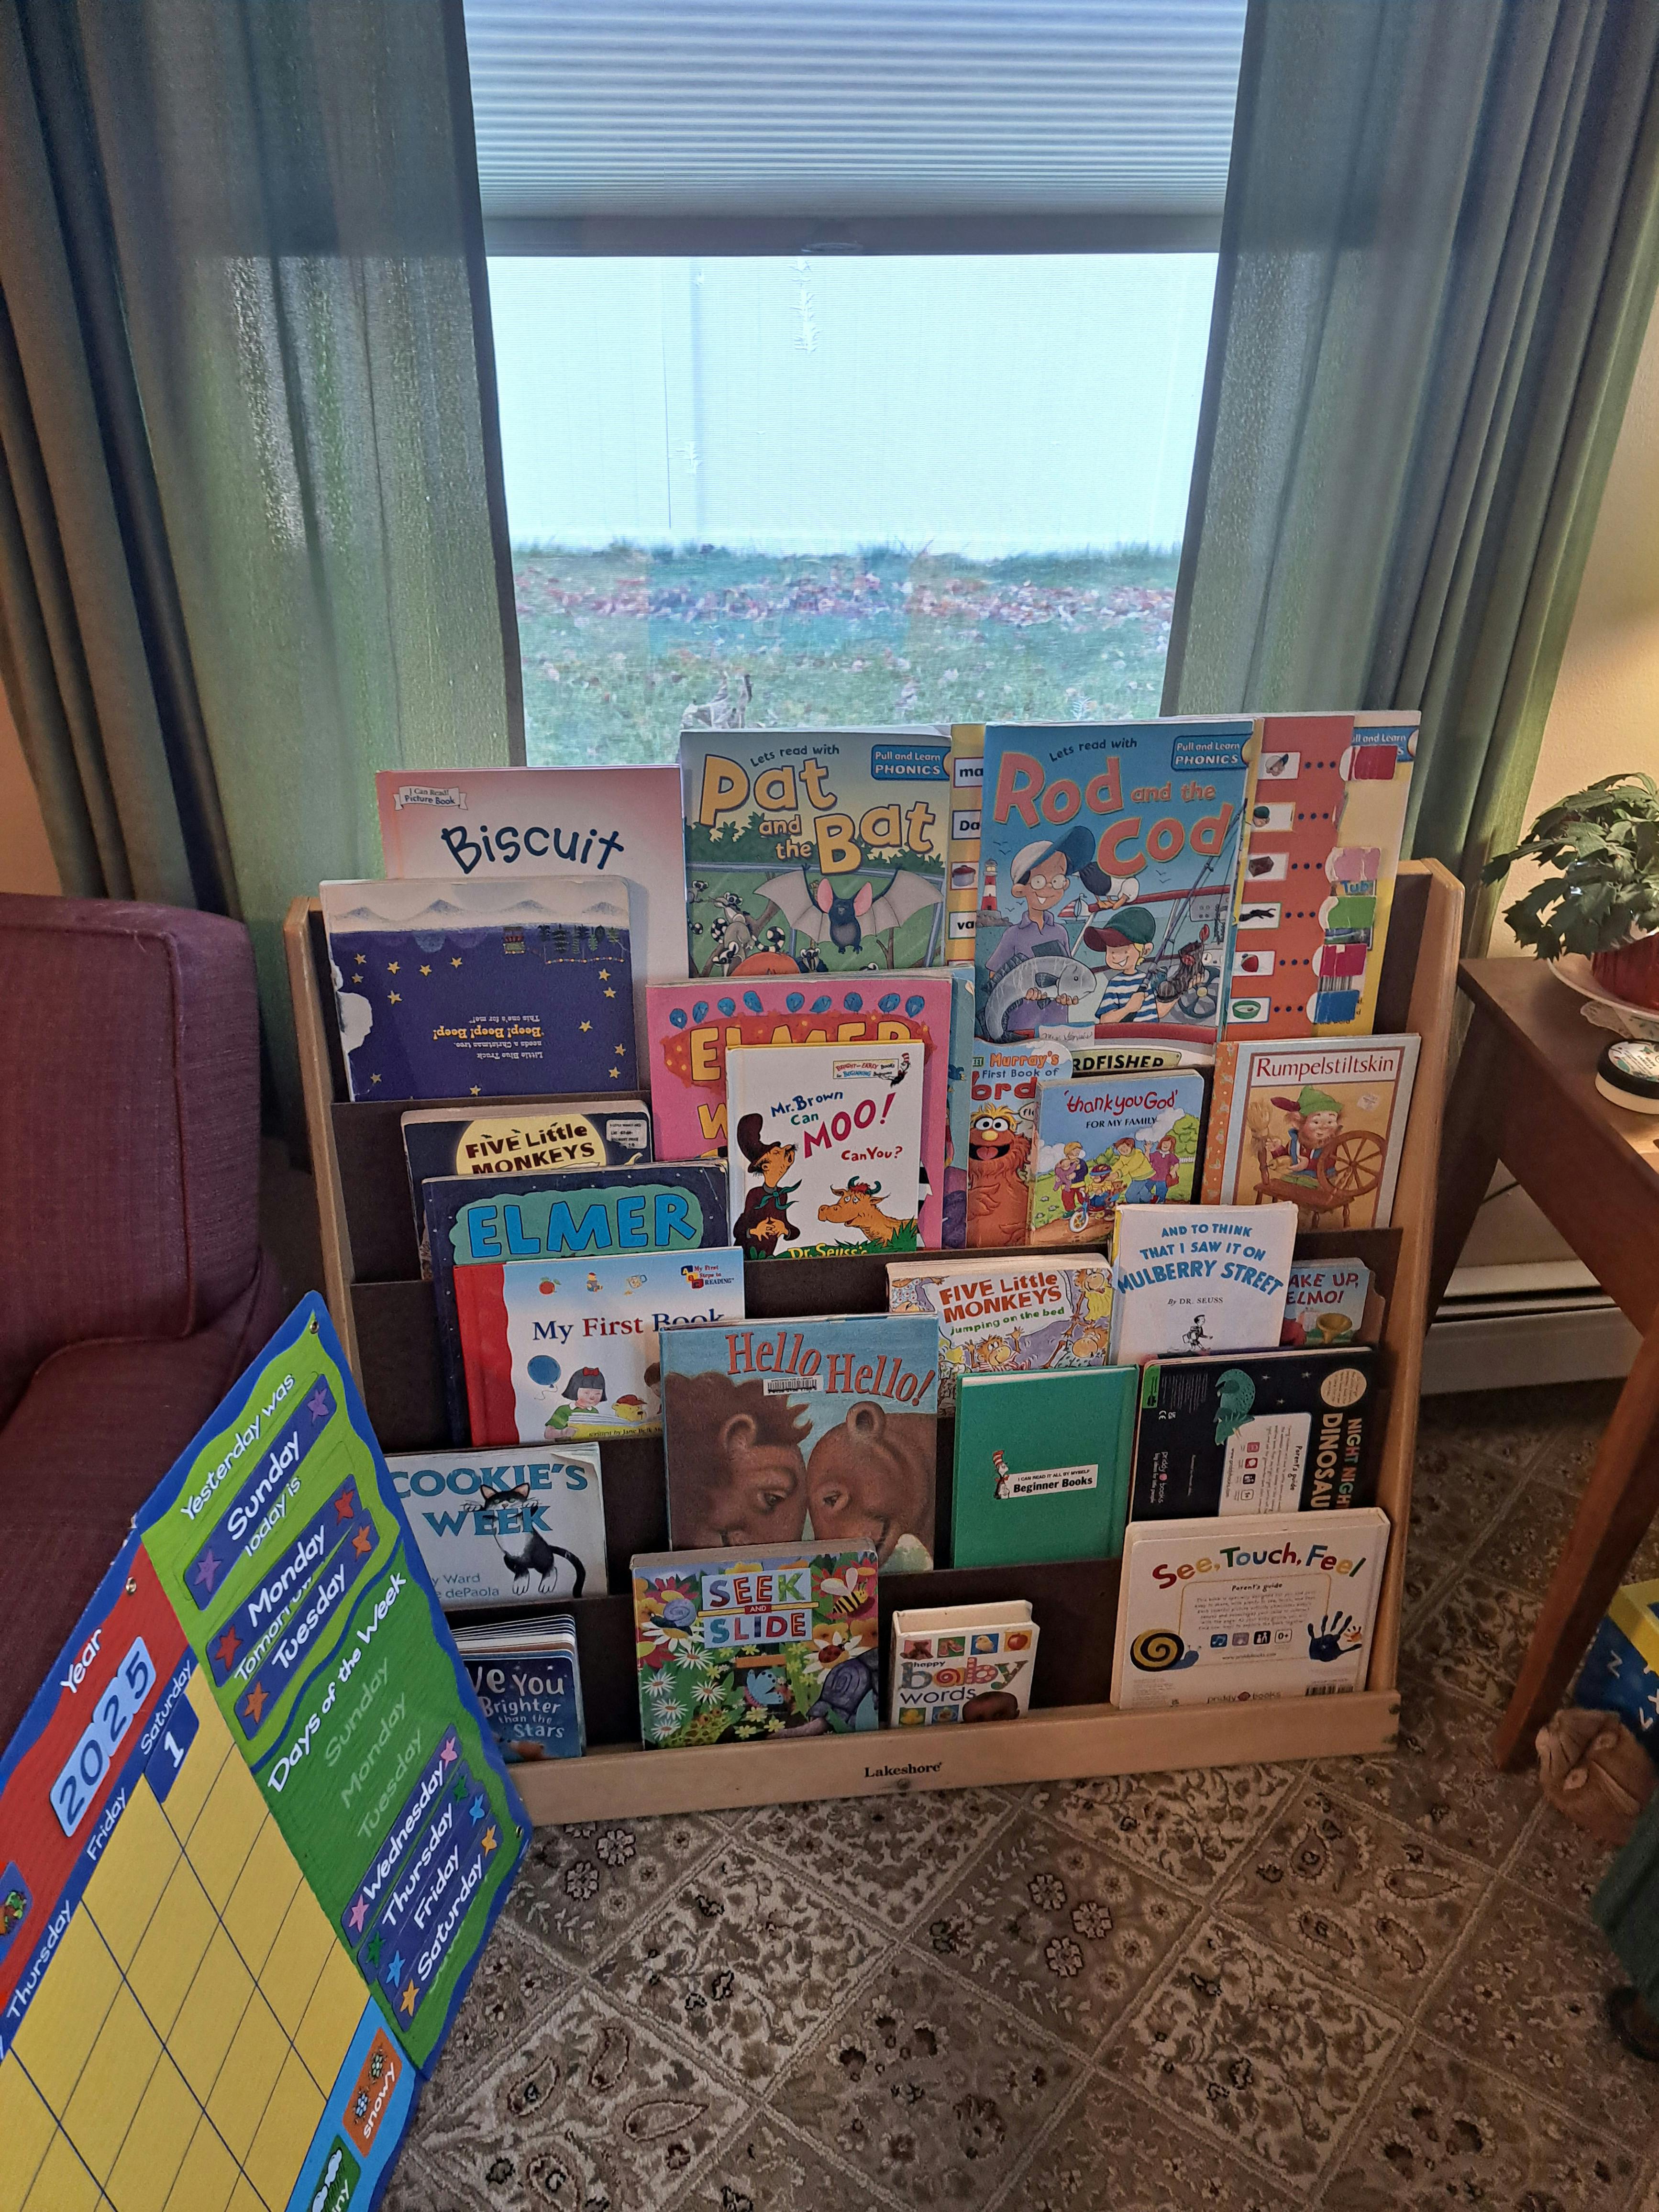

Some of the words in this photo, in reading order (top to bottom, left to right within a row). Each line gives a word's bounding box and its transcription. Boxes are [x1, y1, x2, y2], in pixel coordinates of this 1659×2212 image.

[1049, 747, 1074, 762] Lets
[1079, 740, 1106, 751] read
[1111, 738, 1137, 748] with
[1176, 742, 1194, 751] Pull
[1196, 742, 1213, 751] and
[1215, 741, 1240, 751] Learn
[1352, 734, 1360, 742] ull
[1363, 733, 1380, 742] and
[750, 751, 775, 767] Lets
[780, 746, 807, 757] read
[812, 744, 840, 755] with
[874, 764, 940, 775] PHONICS
[875, 751, 893, 760] Pull
[895, 752, 912, 761] and
[914, 752, 940, 762] Learn
[1175, 754, 1239, 765] PHONICS
[405, 795, 433, 803] Picture
[435, 796, 455, 805] Book
[699, 754, 837, 828] Pat
[993, 751, 1124, 828] Rod
[1131, 782, 1172, 803] and
[1181, 782, 1216, 803] the
[759, 815, 802, 837] and
[814, 801, 936, 875] Bat
[1097, 802, 1234, 878] Cod
[441, 825, 624, 874] Biscuit
[775, 842, 811, 860] the
[1339, 880, 1369, 894] Tub
[433, 1026, 467, 1040] Beep!
[470, 1025, 505, 1039] Beep!
[983, 1070, 1006, 1078] First
[1011, 1069, 1040, 1077] Book
[1045, 1068, 1060, 1076] of
[990, 1051, 1060, 1069] Murray's
[1256, 1055, 1394, 1081] Rumpelstiltskin
[771, 1101, 794, 1117] Mr.
[795, 1090, 843, 1111] Brown
[1113, 1095, 1143, 1116] you
[790, 1112, 818, 1126] Can
[804, 1092, 896, 1159] MOO!
[1086, 1120, 1105, 1128] FOR
[1125, 1117, 1156, 1126] FAMILY
[465, 1135, 522, 1159] FIVE
[526, 1122, 588, 1147] Little
[471, 1142, 596, 1174] MONKEYS
[467, 1194, 697, 1259] ELMER
[1161, 1227, 1187, 1238] AND
[1191, 1224, 1208, 1234] TO
[1212, 1223, 1253, 1238] THINK
[1139, 1244, 1175, 1260] THAT
[1180, 1243, 1184, 1254] I
[1191, 1241, 1221, 1253] SAW
[1226, 1242, 1242, 1254] IT
[1242, 1247, 1266, 1261] ON
[939, 1279, 993, 1306] FIVE
[999, 1272, 1058, 1294] Little
[1117, 1260, 1217, 1294] MULBERRY
[1220, 1262, 1284, 1295] STREET
[1290, 1273, 1325, 1287] AKE
[1332, 1273, 1359, 1288] UP,
[942, 1285, 1062, 1324] MONKEYS
[1286, 1291, 1345, 1305] ELMO!
[532, 1320, 574, 1344] My
[582, 1316, 643, 1337] First
[950, 1319, 1001, 1336] jumping
[1003, 1315, 1018, 1323] on
[1020, 1310, 1040, 1321] the
[1042, 1307, 1065, 1317] bed
[725, 1331, 821, 1376] Hello
[825, 1353, 936, 1406] Hello!
[180, 1416, 261, 1520] Yesterday
[261, 1372, 296, 1418] was
[1344, 1418, 1362, 1464] NIGHT
[1292, 1445, 1303, 1472] Parent's
[1311, 1413, 1343, 1509] DINOSAU
[227, 1432, 300, 1540] Sunday
[288, 1476, 302, 1499] is
[391, 1464, 588, 1499] COOKIE'S
[1014, 1481, 1059, 1493] Beginner
[1062, 1477, 1093, 1488] Books
[1158, 1483, 1168, 1504] books
[1288, 1474, 1298, 1491] guide
[422, 1505, 553, 1537] WEEK
[247, 1526, 326, 1627] Monday
[442, 1573, 480, 1583] Ward
[1152, 1557, 1220, 1589] See,
[1220, 1542, 1301, 1568] Touch,
[1305, 1545, 1366, 1578] Feel
[446, 1587, 499, 1598] dePaola
[709, 1573, 806, 1607] SEEK
[1262, 1583, 1283, 1593] guide
[271, 1564, 346, 1670] Tuesday
[710, 1613, 806, 1643] SLIDE
[60, 1629, 102, 1694] Year
[898, 1657, 1029, 1690] baby
[913, 1660, 945, 1668] happy
[267, 1713, 321, 1793] Days
[320, 1681, 337, 1715] of
[337, 1648, 362, 1684] the
[356, 1572, 407, 1647] Week
[512, 1673, 564, 1696] You
[900, 1687, 977, 1704] words
[140, 1659, 191, 1756] Saturday
[324, 1657, 389, 1769] Sunday
[478, 1697, 561, 1717] Brighter
[498, 1715, 526, 1723] than
[532, 1714, 552, 1723] the
[58, 1650, 150, 1827] 2025
[513, 1724, 564, 1738] Stars
[164, 1735, 185, 1768] 1
[341, 1692, 408, 1810] Monday
[357, 1728, 422, 1841] Tuesday
[86, 1788, 127, 1861] Friday
[363, 1760, 445, 1901] Wednesday
[381, 1803, 454, 1927] Thursday
[413, 1845, 460, 1931] Friday
[417, 1853, 483, 1981] Saturday
[7, 1900, 71, 2019] Thursday
[363, 2062, 395, 2139] snowy
